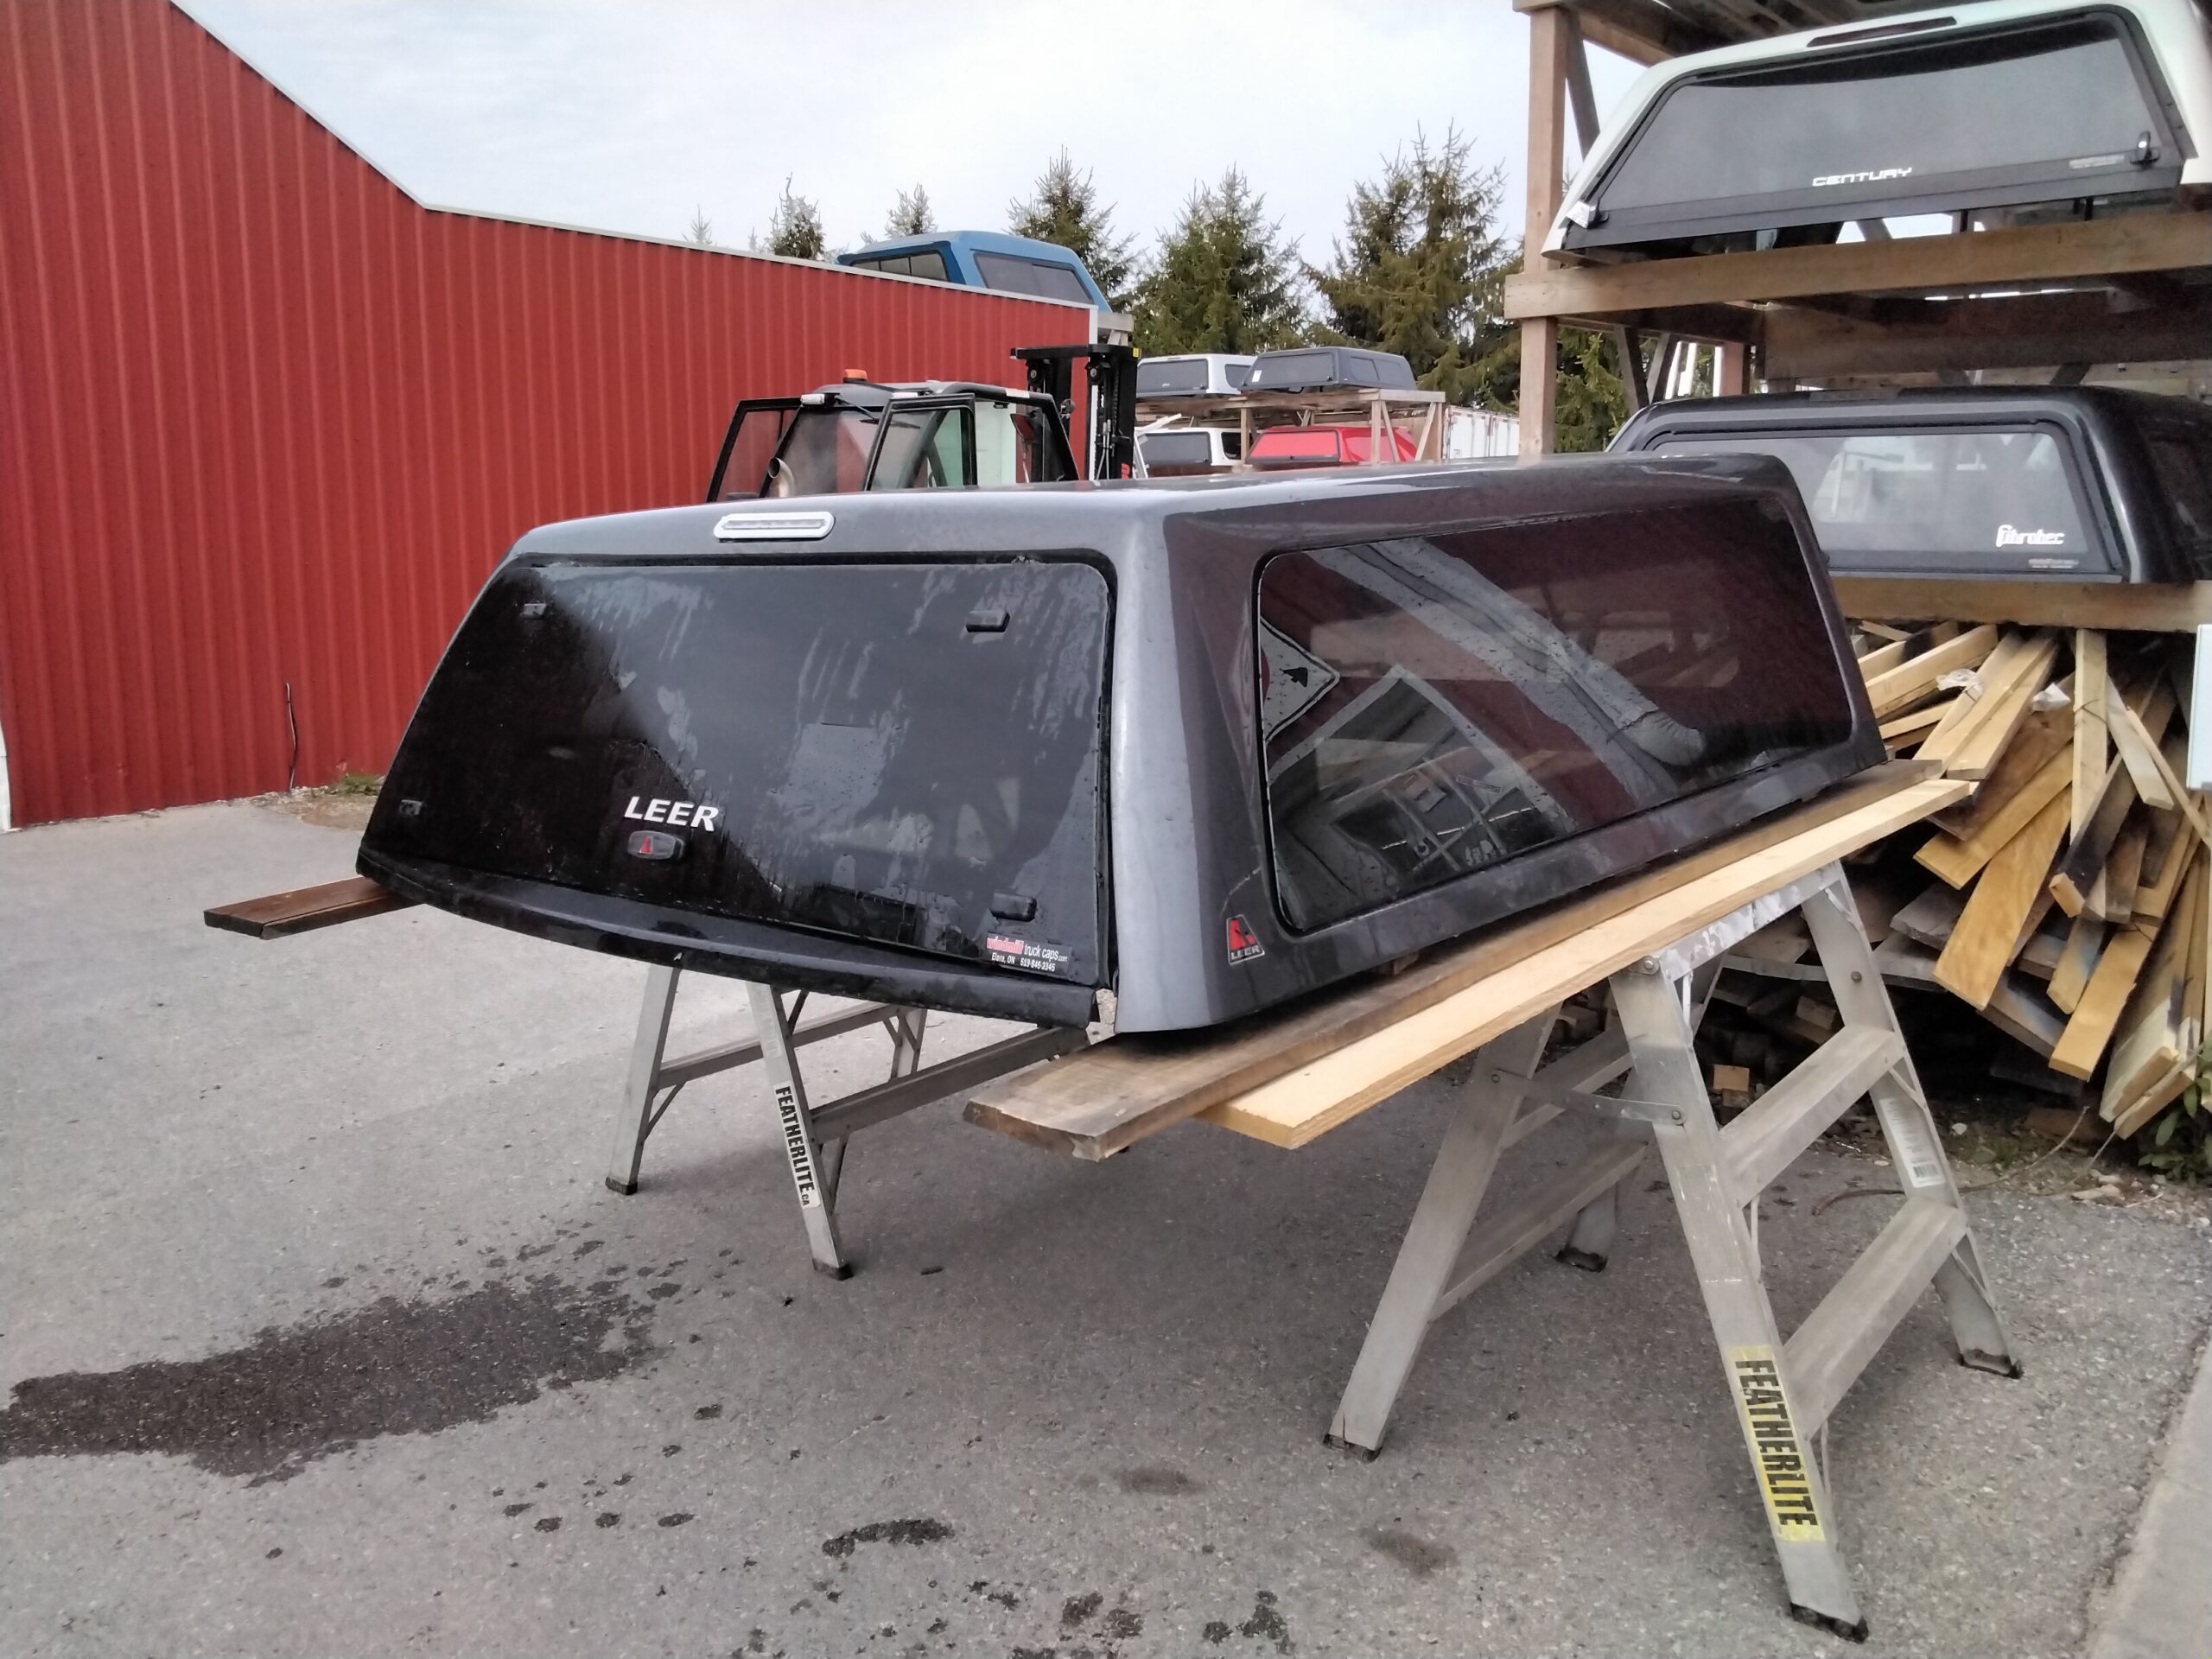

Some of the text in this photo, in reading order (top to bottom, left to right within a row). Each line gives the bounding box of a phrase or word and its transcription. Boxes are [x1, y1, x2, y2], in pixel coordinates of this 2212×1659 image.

[1812, 167, 1912, 187] CENTURY
[624, 796, 719, 832] LEER
[1007, 955, 1015, 964] ON
[1024, 944, 1040, 957] truck
[1230, 944, 1260, 960] LEER
[1735, 1360, 1818, 1526] FEATHERLITE
